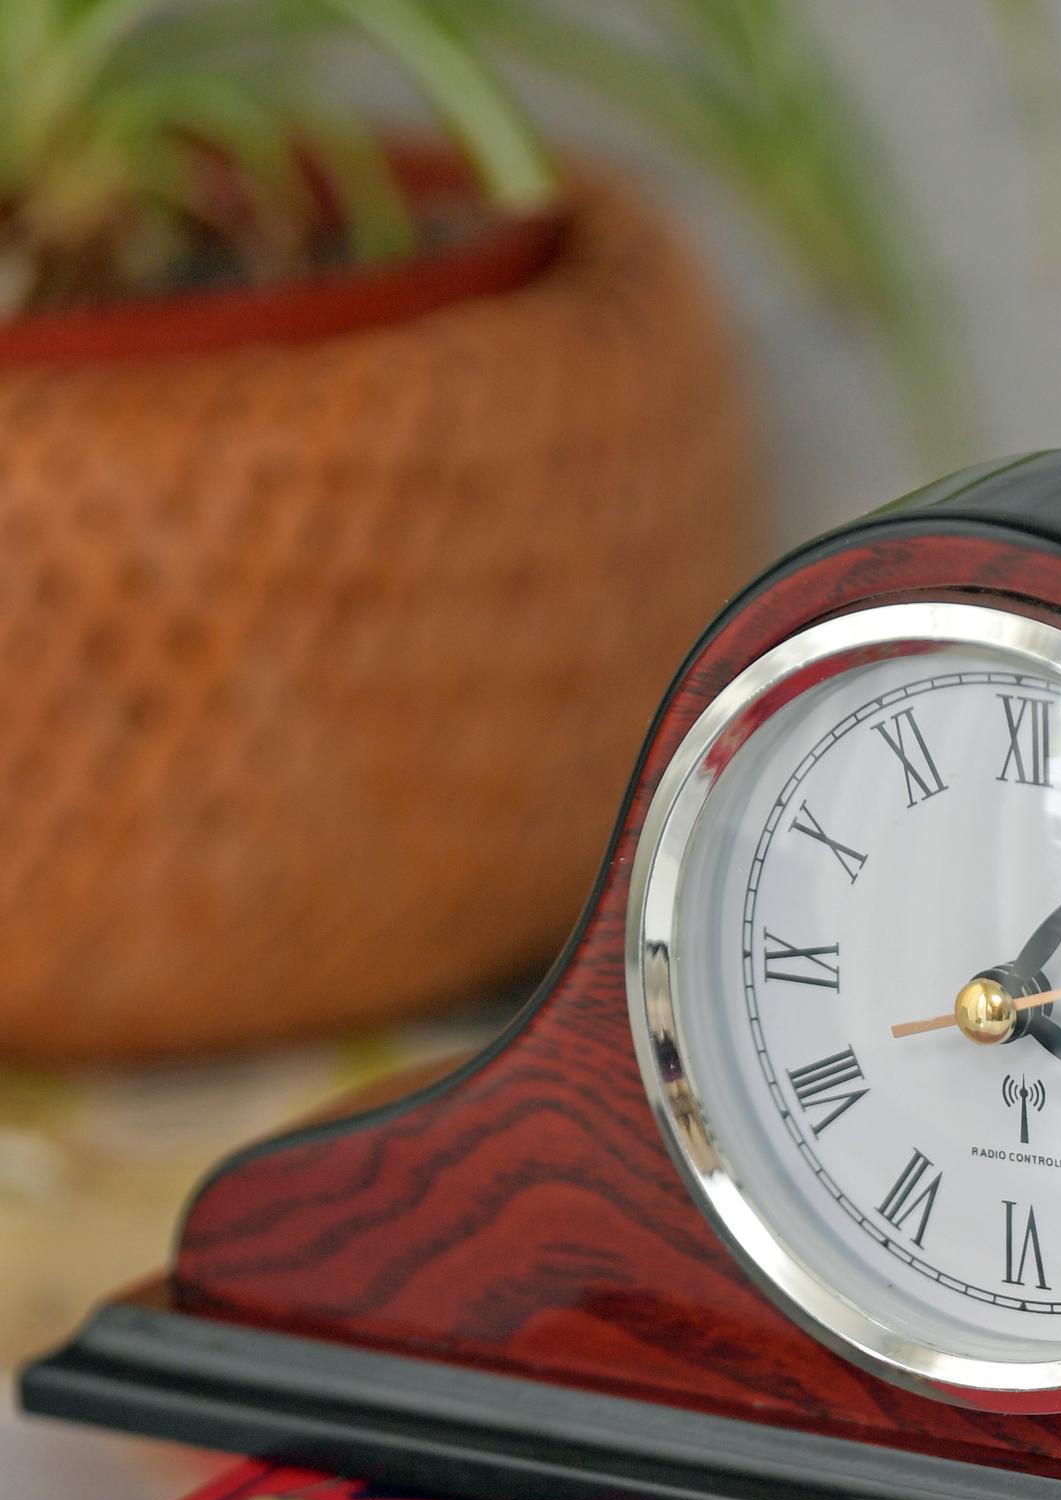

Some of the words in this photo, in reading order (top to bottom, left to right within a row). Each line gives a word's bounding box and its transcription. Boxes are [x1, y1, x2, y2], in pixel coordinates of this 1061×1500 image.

[870, 706, 949, 808] XI
[995, 694, 1054, 788] XII
[789, 800, 868, 884] X
[764, 926, 840, 994] IX
[785, 1043, 871, 1140] VIII
[873, 1146, 943, 1250] VII
[971, 1146, 1006, 1160] RADIO
[1001, 1200, 1053, 1290] VI
